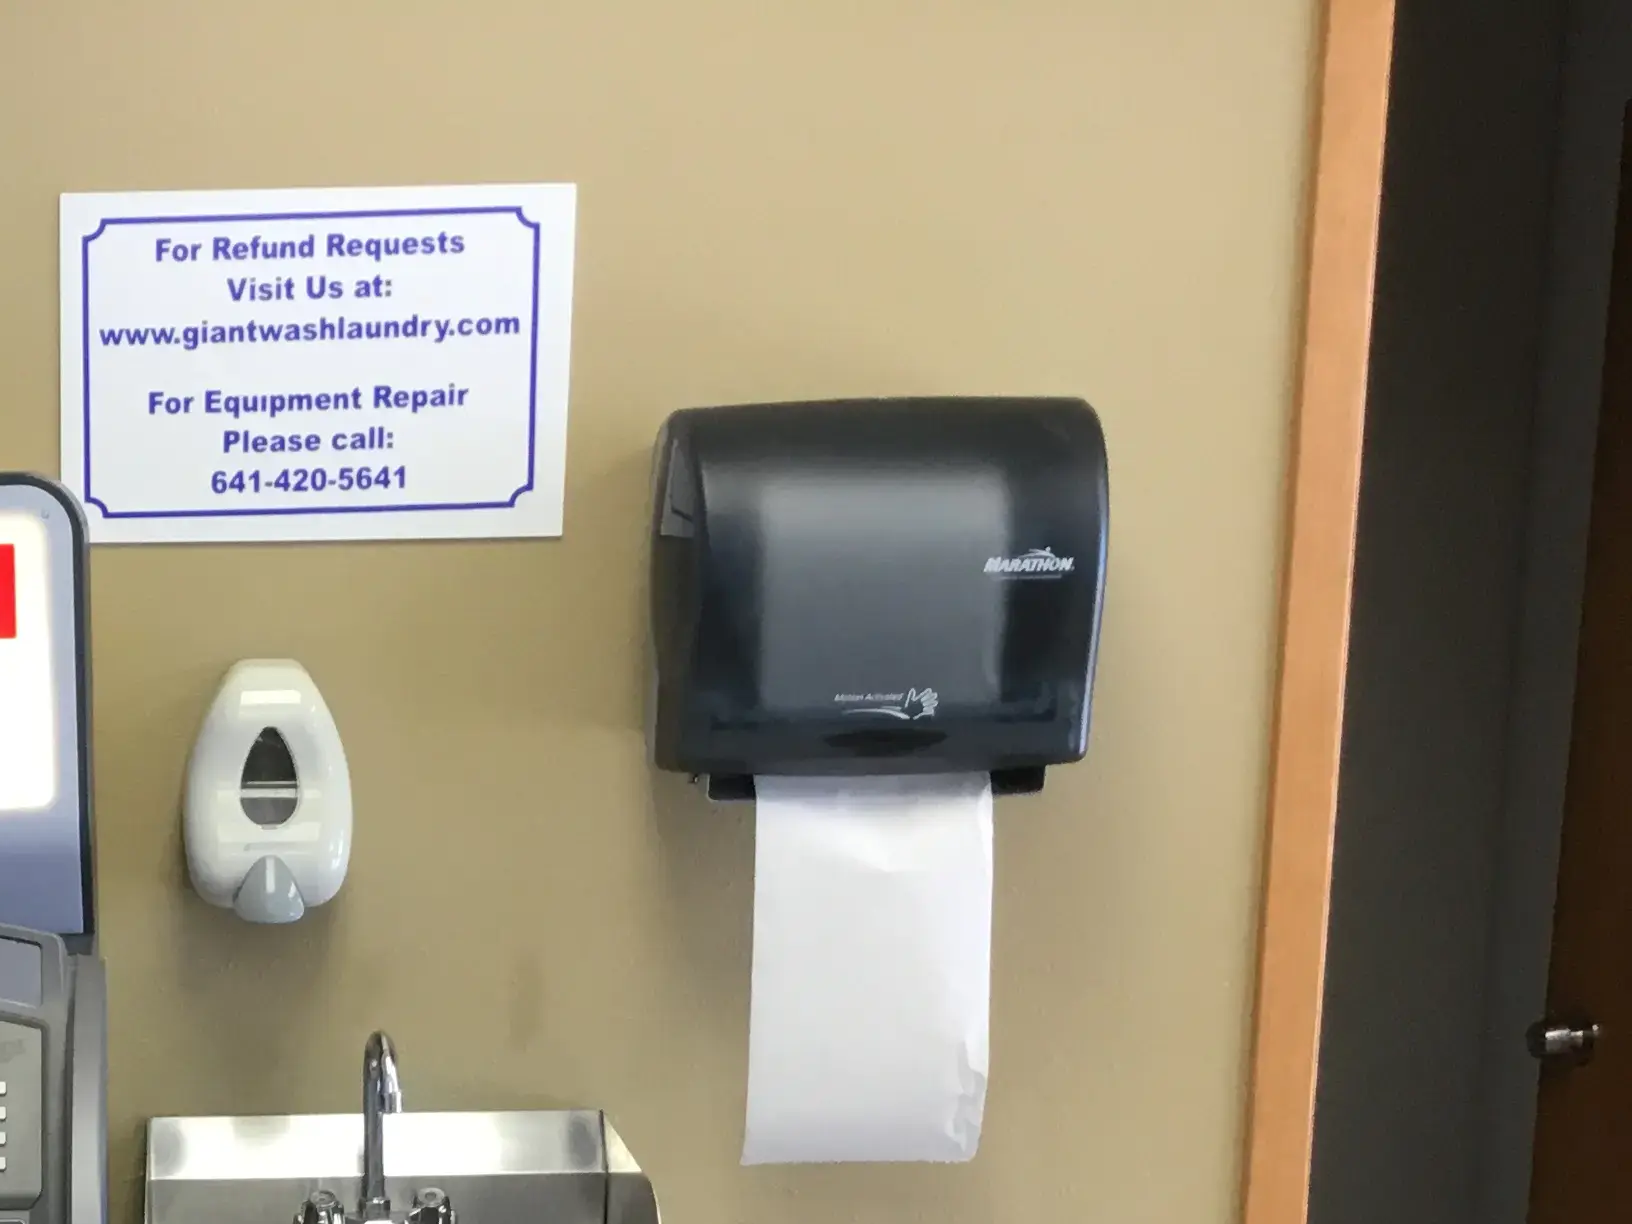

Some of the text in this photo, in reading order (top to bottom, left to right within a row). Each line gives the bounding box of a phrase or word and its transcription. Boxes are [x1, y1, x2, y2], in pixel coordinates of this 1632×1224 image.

[155, 231, 465, 262] For Refund Requests
[227, 275, 393, 301] Visit Us at:
[99, 315, 520, 350] www.giantwashlaundry.com
[148, 384, 469, 418] For Equipment Repair
[223, 427, 395, 453] Please call:
[211, 467, 407, 494] 641-420-5641
[983, 556, 1074, 573] MARATHON
